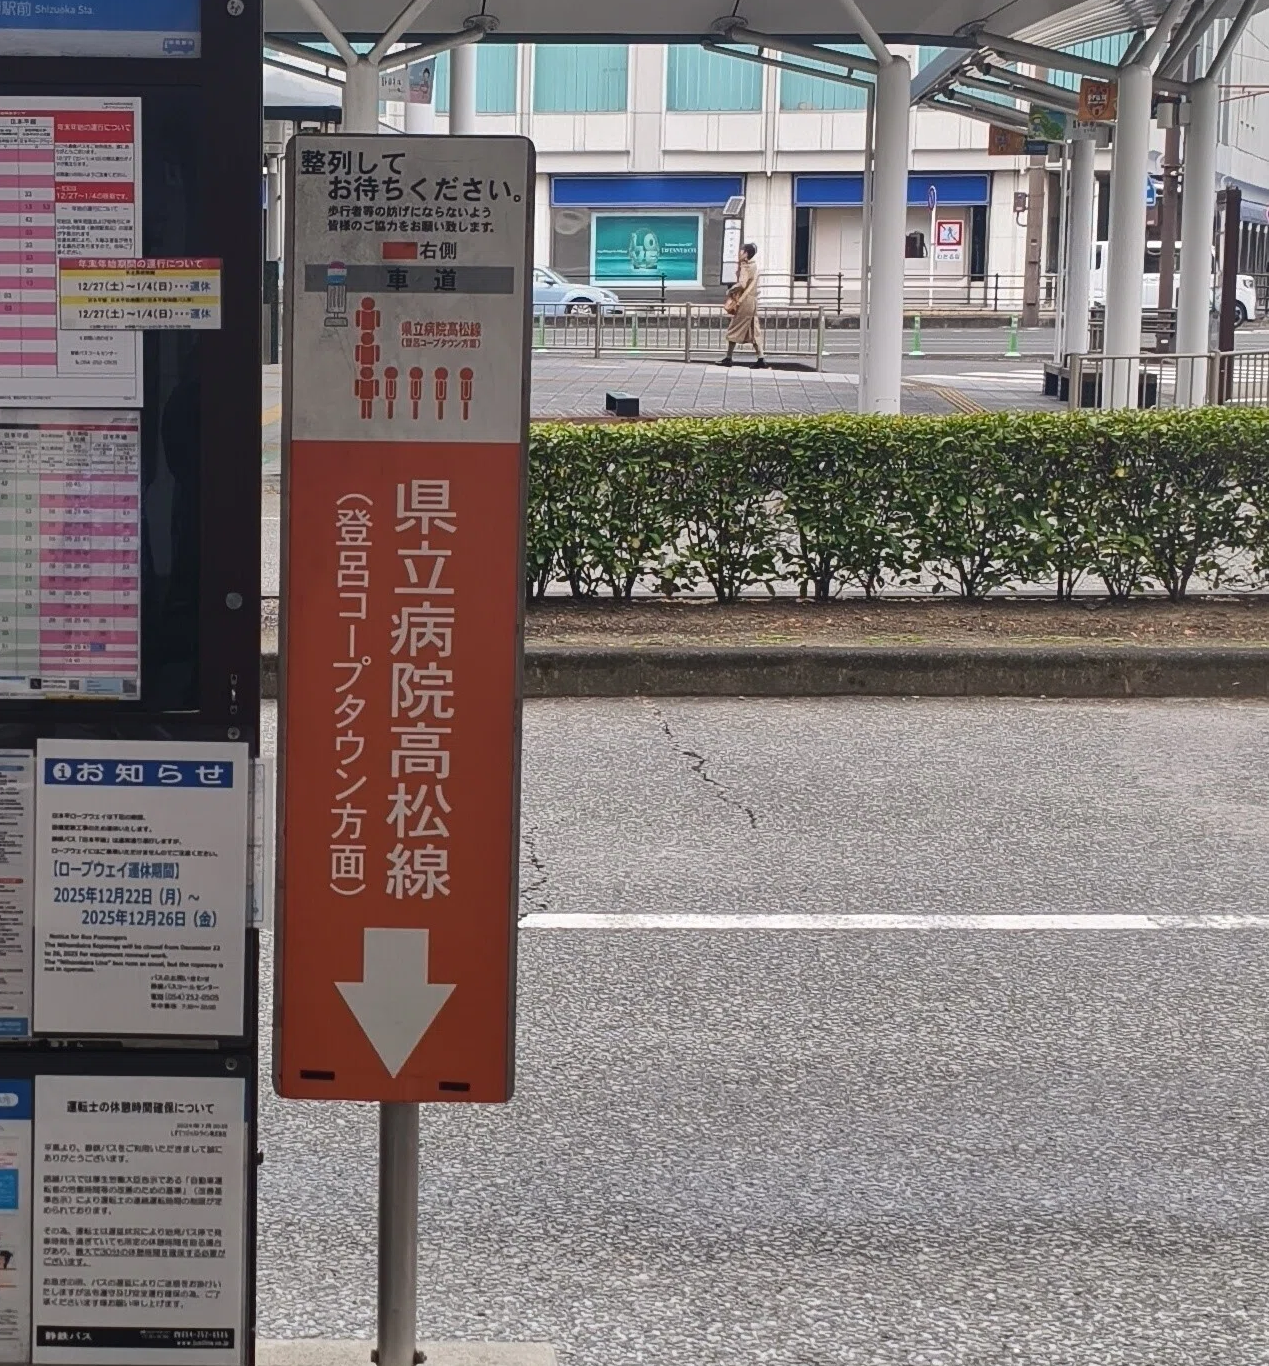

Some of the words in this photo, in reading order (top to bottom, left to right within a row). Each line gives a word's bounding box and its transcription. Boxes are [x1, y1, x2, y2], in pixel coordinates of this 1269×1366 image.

[35, 4, 76, 15] Shizuoka
[301, 150, 406, 175] 整列して
[328, 177, 522, 203] お待ちください。
[328, 205, 492, 218] 歩行者等の妨げにならないよう
[419, 241, 457, 260] 右側
[401, 321, 482, 337] 県立病院高松線
[385, 478, 458, 901] 県立病院高松線
[76, 763, 224, 784] お知らせ
